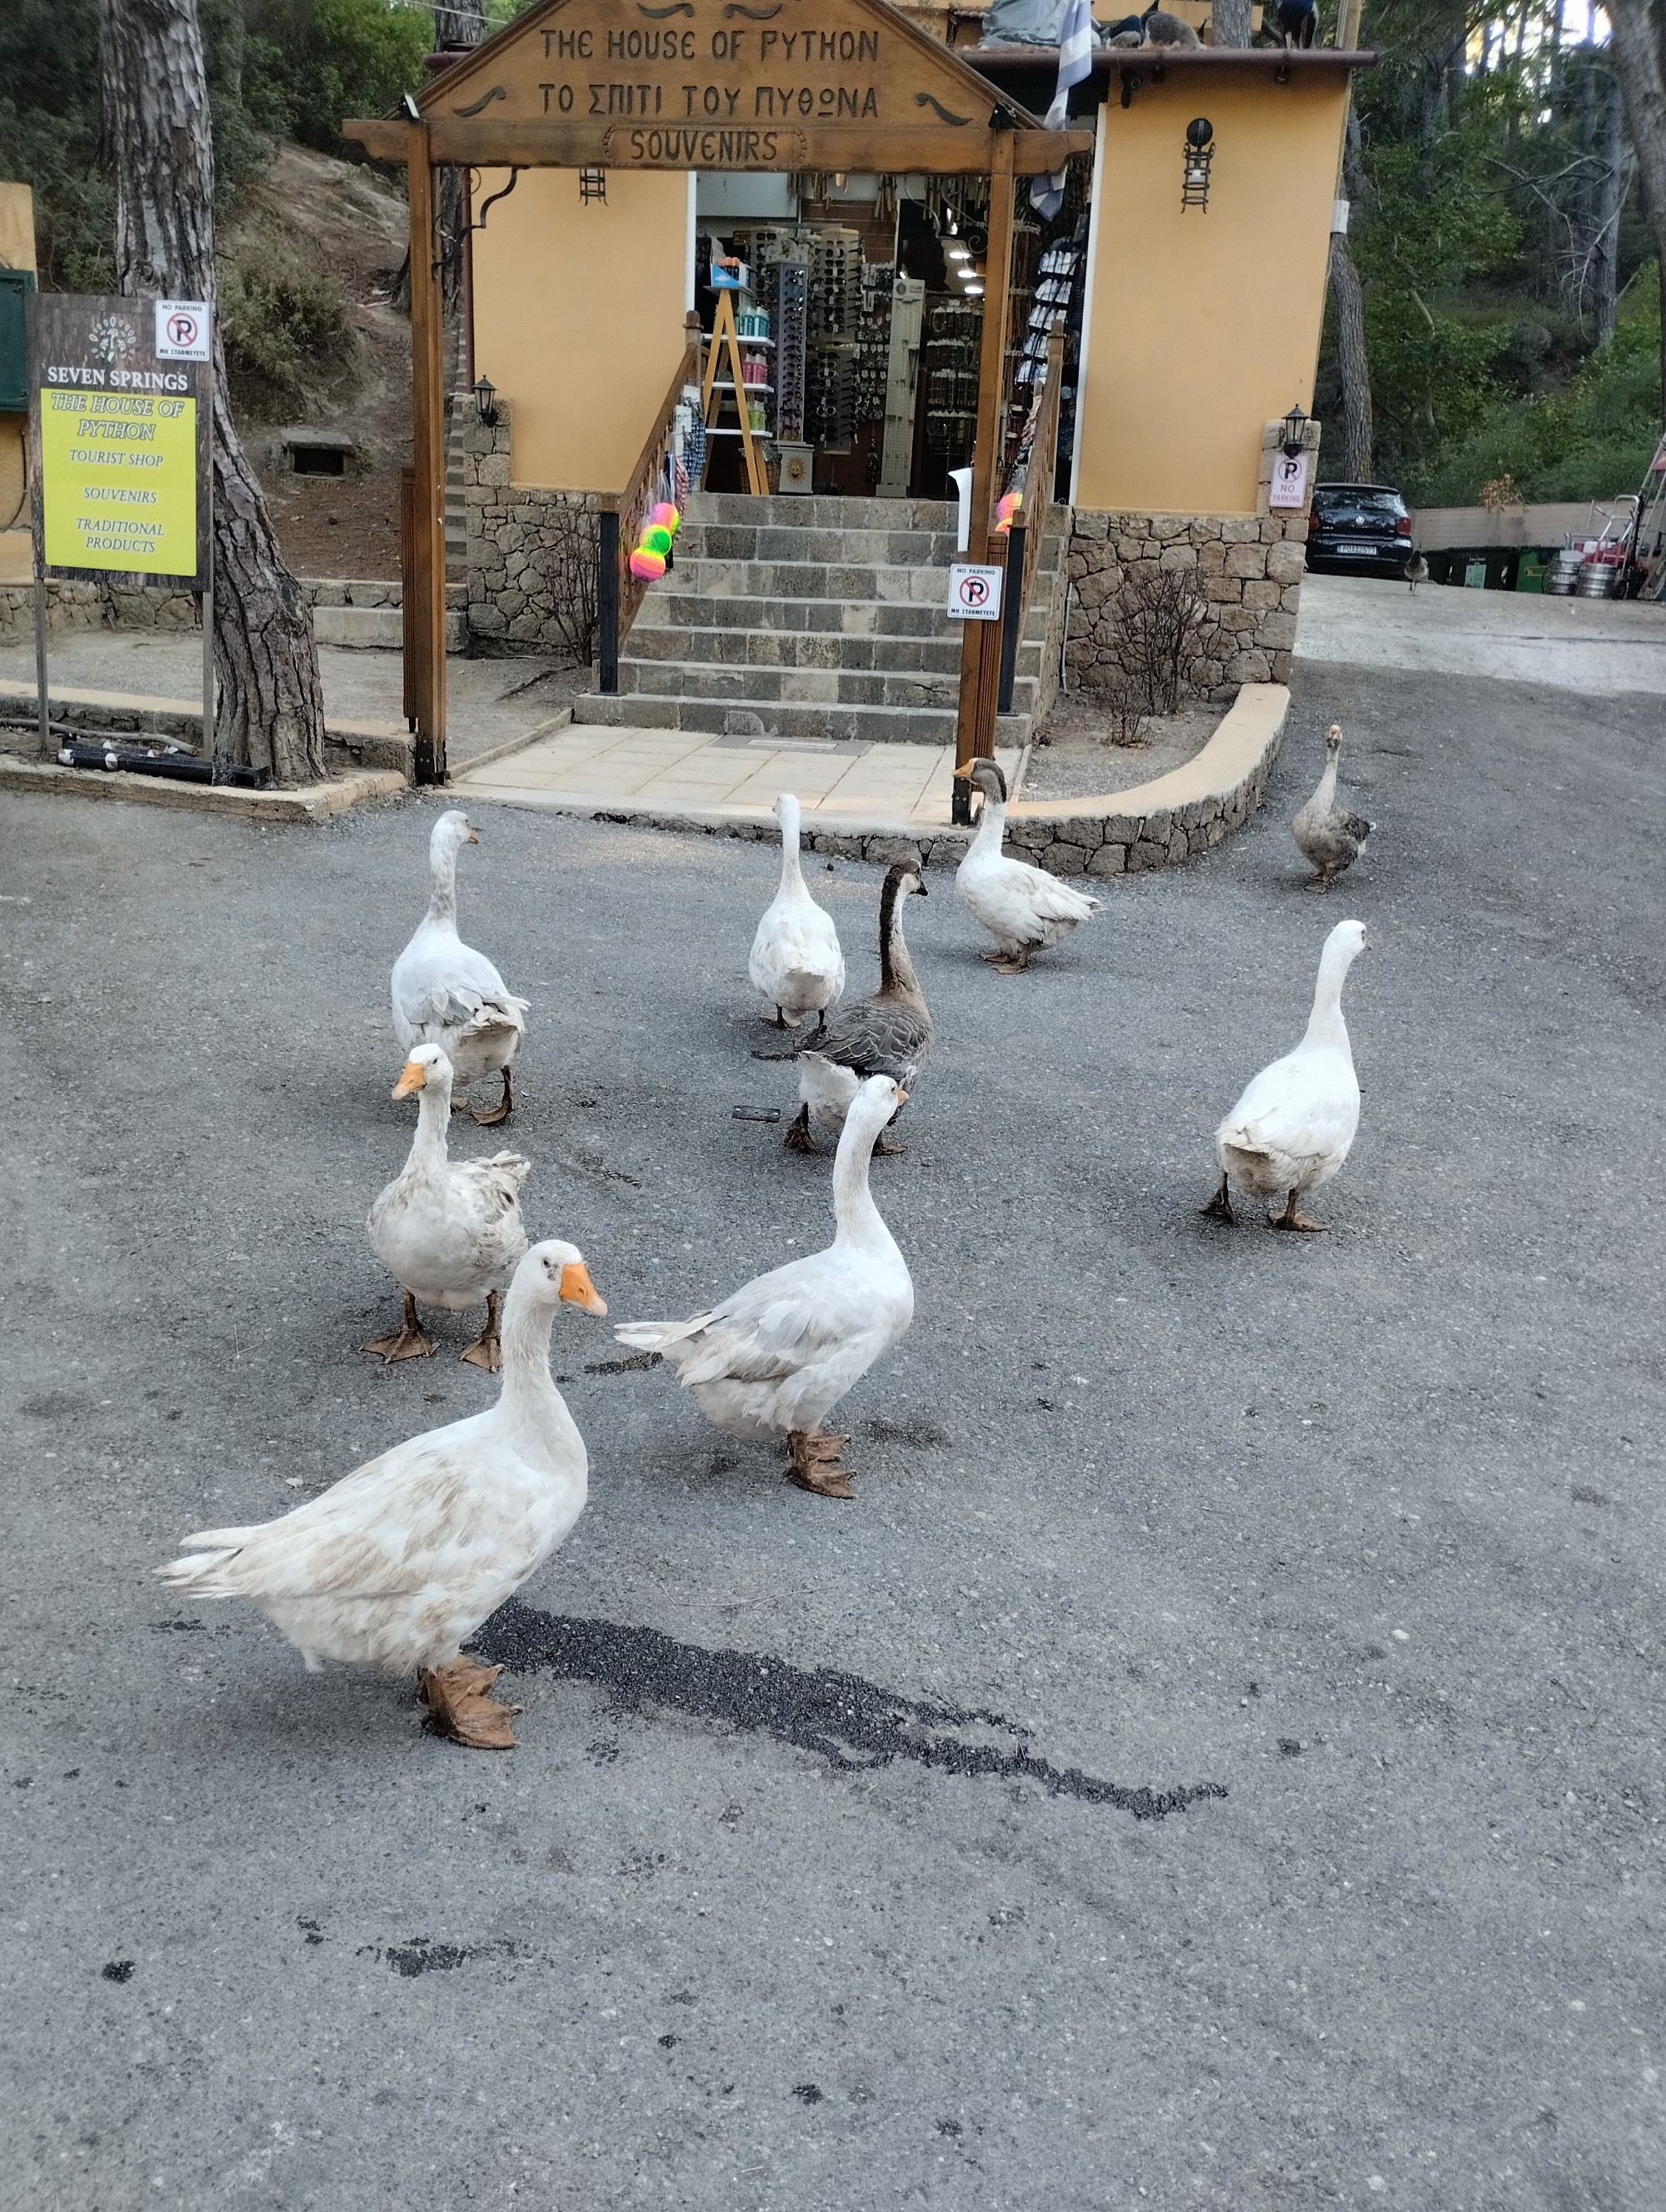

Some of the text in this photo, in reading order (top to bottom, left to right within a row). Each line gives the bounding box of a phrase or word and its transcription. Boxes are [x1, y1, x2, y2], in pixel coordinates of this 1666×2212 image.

[540, 30, 879, 62] THE HOUSE OF PYTHON
[539, 83, 575, 113] ΤΟ
[588, 84, 662, 115] ΣΠΙΤΙ
[681, 85, 741, 117] ΤΟΥ
[631, 129, 779, 162] SOUVENIRS
[47, 366, 188, 391] SEVEN SPRINGS
[52, 393, 185, 418] THE HOUSE OF
[77, 420, 157, 441] PYTHON
[69, 449, 163, 467] TOURIST SHOP
[83, 487, 157, 503] SOUVENIRS
[1272, 494, 1301, 503] PARKING
[1280, 484, 1295, 493] NO
[76, 517, 165, 536] TRADITIONAL
[86, 536, 156, 553] PRODUCTS
